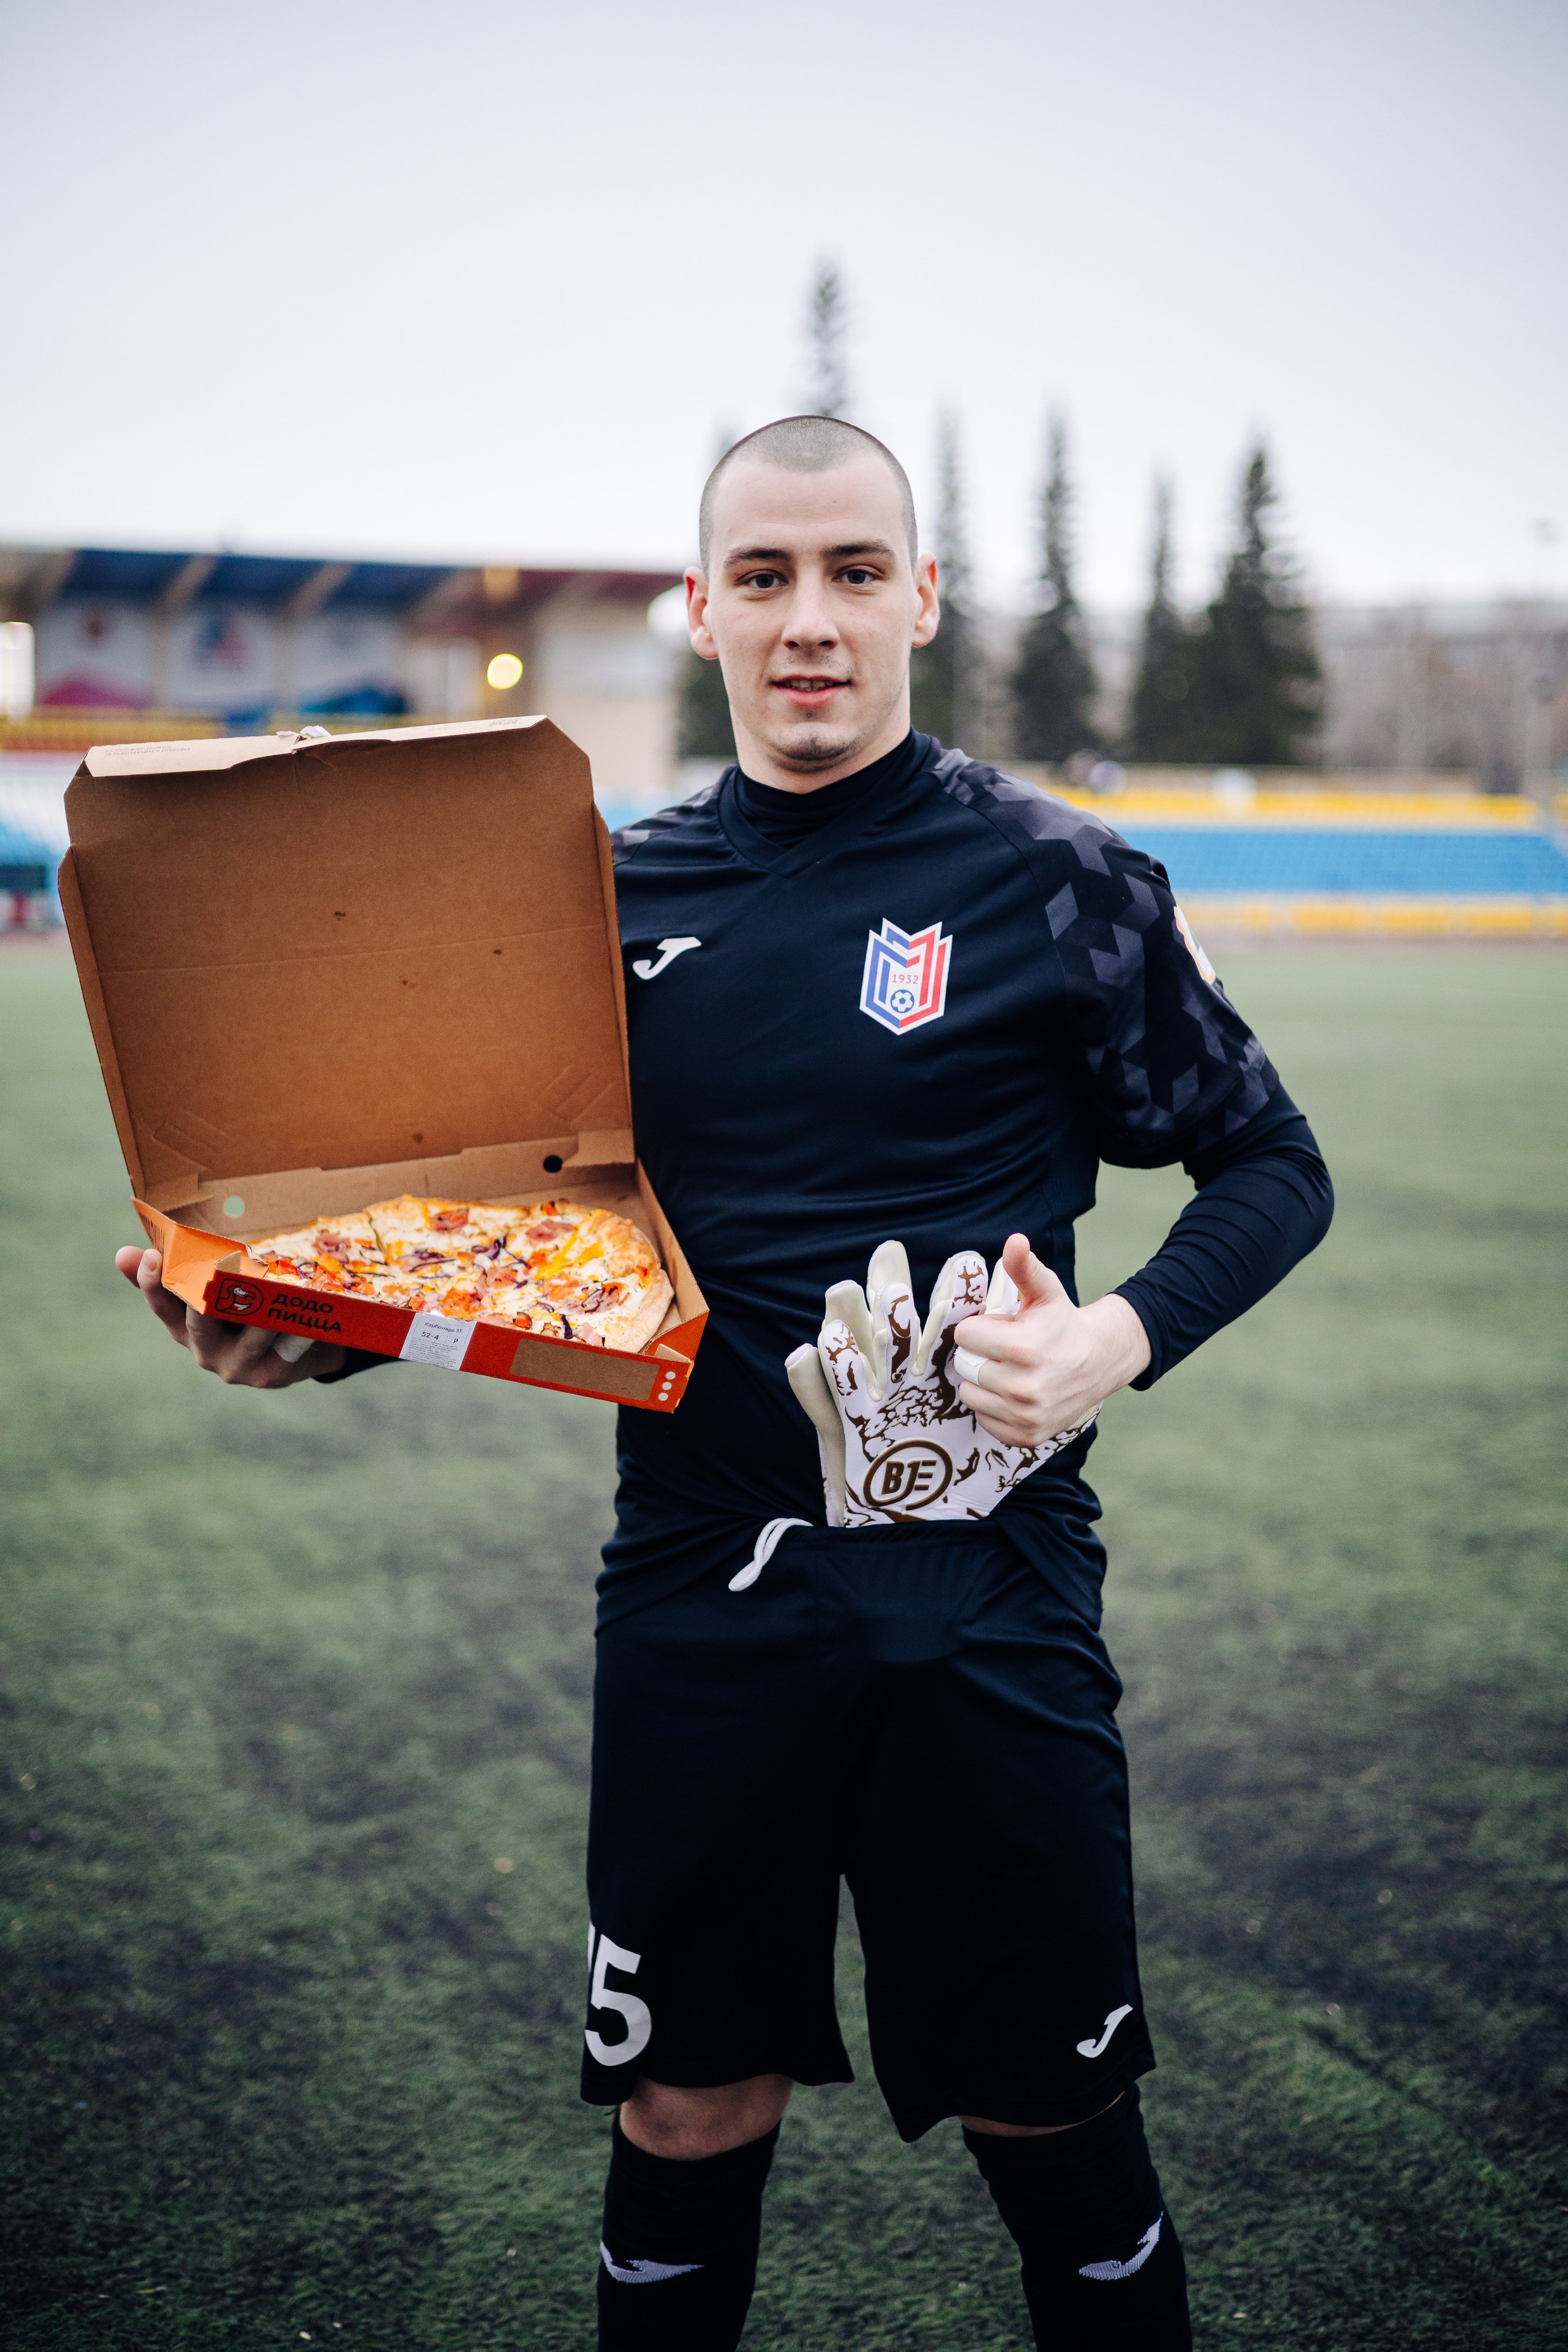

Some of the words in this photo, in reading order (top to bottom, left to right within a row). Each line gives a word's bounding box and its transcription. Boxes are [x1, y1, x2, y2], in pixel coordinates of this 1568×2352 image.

[891, 974, 919, 984] 1932
[271, 1294, 334, 1314] ДОДО
[267, 1308, 342, 1333] ПИЦЦА
[424, 1322, 455, 1332] Карбонара
[421, 1331, 439, 1340] 52-4
[584, 1920, 652, 2067] 5
